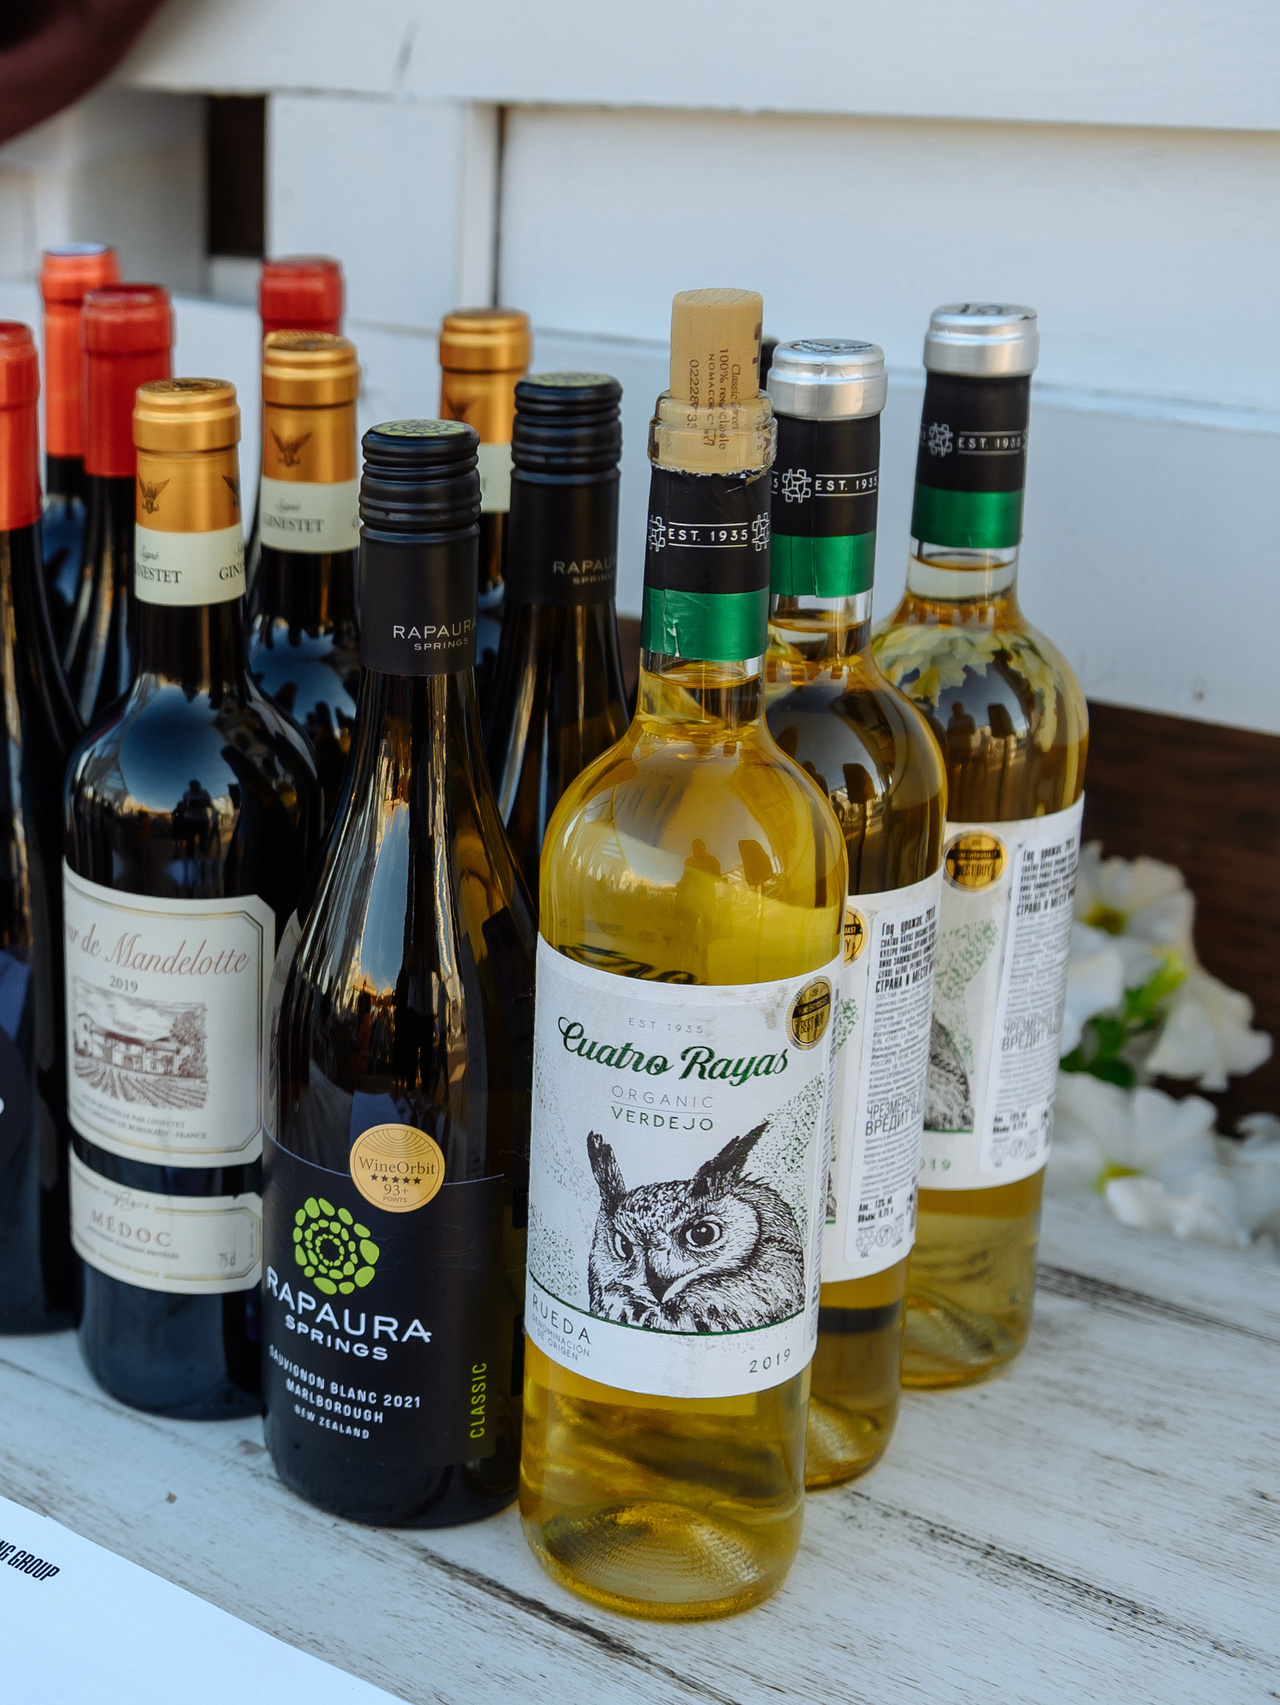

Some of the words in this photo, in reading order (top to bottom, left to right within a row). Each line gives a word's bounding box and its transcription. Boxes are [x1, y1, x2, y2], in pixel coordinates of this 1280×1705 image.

[719, 348, 729, 383] 100%
[815, 479, 848, 491] EST.
[855, 476, 878, 490] 1935
[668, 528, 701, 542] EST.
[710, 529, 748, 542] 1935
[414, 636, 469, 651] SPRINGS
[82, 922, 102, 957] de
[105, 932, 251, 976] Mandelotte
[109, 975, 139, 994] 2019
[875, 975, 903, 993] СТРАНА
[558, 1016, 674, 1076] Cuatro
[678, 1045, 789, 1087] Rayas
[611, 1085, 714, 1109] ORGANIC
[610, 1105, 714, 1131] VERDEJO
[865, 1110, 909, 1137] ВРЕДИТ
[359, 1156, 437, 1175] WineOrbit
[383, 1183, 409, 1196] 93+
[267, 1266, 433, 1343] RAPAURA
[532, 1292, 592, 1346] RUEDA
[284, 1314, 389, 1361] SPRINGS
[547, 1337, 580, 1361] ORIGEN
[748, 1347, 791, 1374] 2019
[268, 1344, 325, 1390] SAUVIGNON
[330, 1381, 378, 1405] BLANC
[383, 1394, 421, 1409] 2021
[285, 1377, 384, 1424] MARLBOROUGH
[469, 1362, 488, 1439] CLASSIC
[294, 1403, 316, 1422] NEW
[319, 1416, 370, 1440] ZEALAND
[6, 1550, 61, 1582] GROUP
